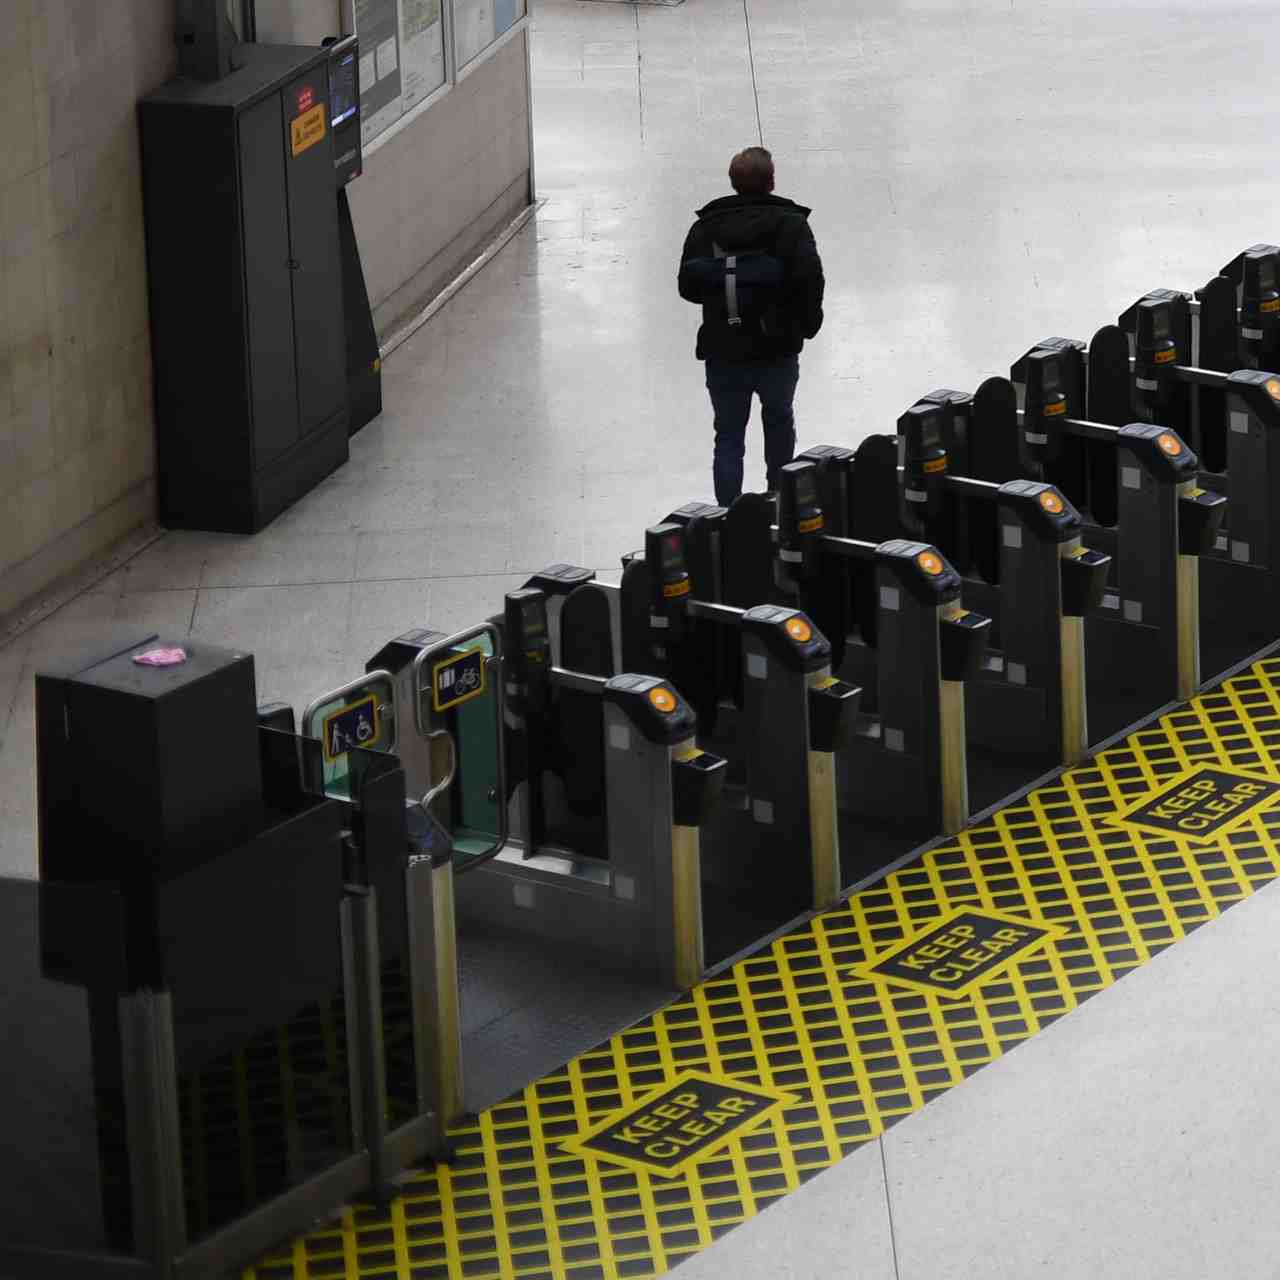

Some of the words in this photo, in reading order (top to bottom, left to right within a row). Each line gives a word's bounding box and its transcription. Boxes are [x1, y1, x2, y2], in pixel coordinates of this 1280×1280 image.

[1147, 780, 1218, 820] KEEP
[1177, 782, 1267, 832] CLEAR
[898, 924, 977, 970] KEEP
[928, 927, 1028, 981] CLEAR
[612, 1091, 699, 1145] KEEP
[644, 1096, 757, 1158] CLEAR
